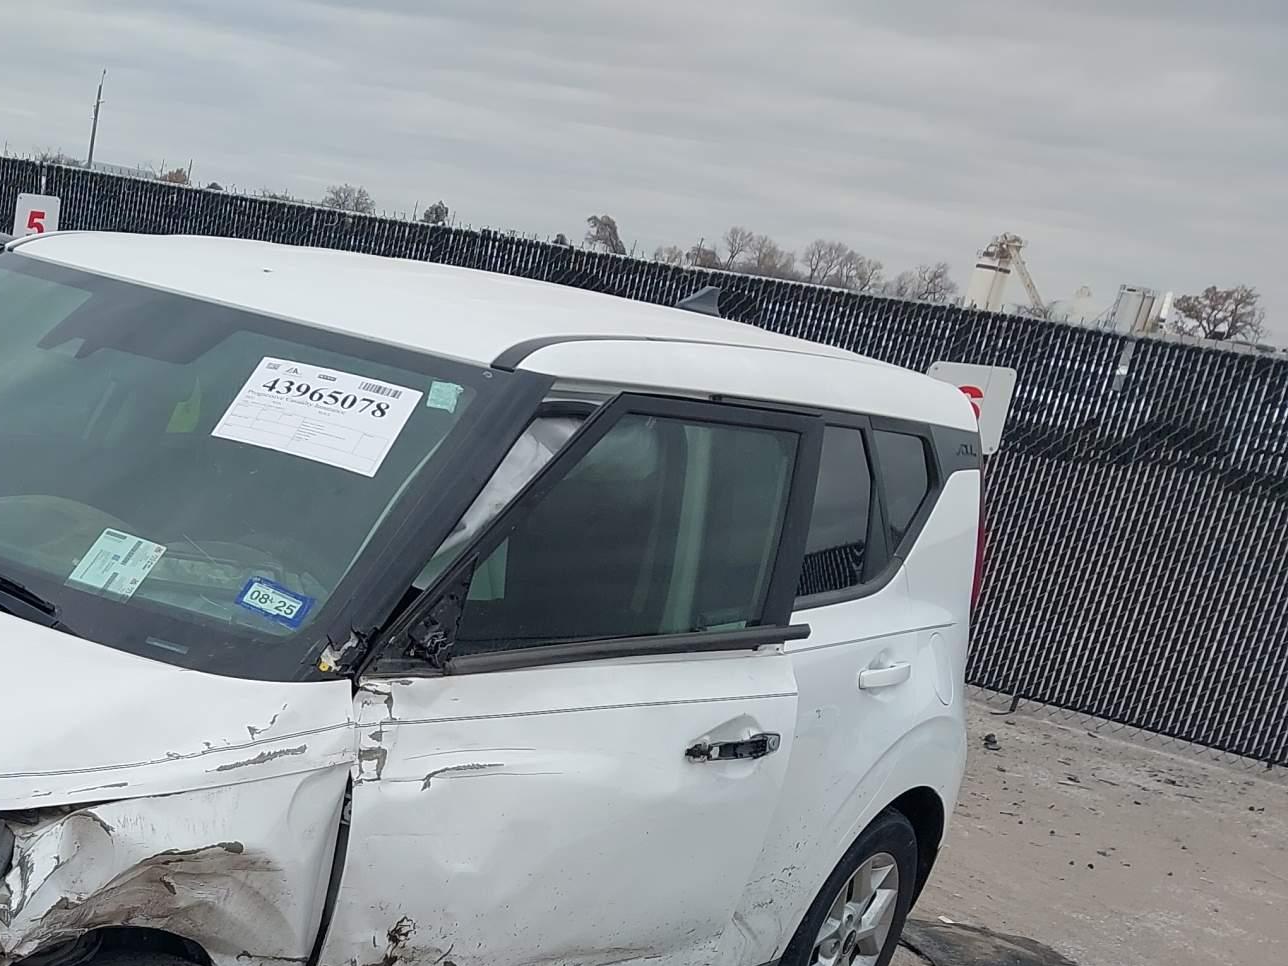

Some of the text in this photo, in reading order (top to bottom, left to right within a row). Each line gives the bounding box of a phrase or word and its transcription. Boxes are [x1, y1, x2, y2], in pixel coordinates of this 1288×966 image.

[27, 211, 46, 233] 5
[262, 377, 390, 418] 43965078
[250, 590, 296, 616] 08 25
